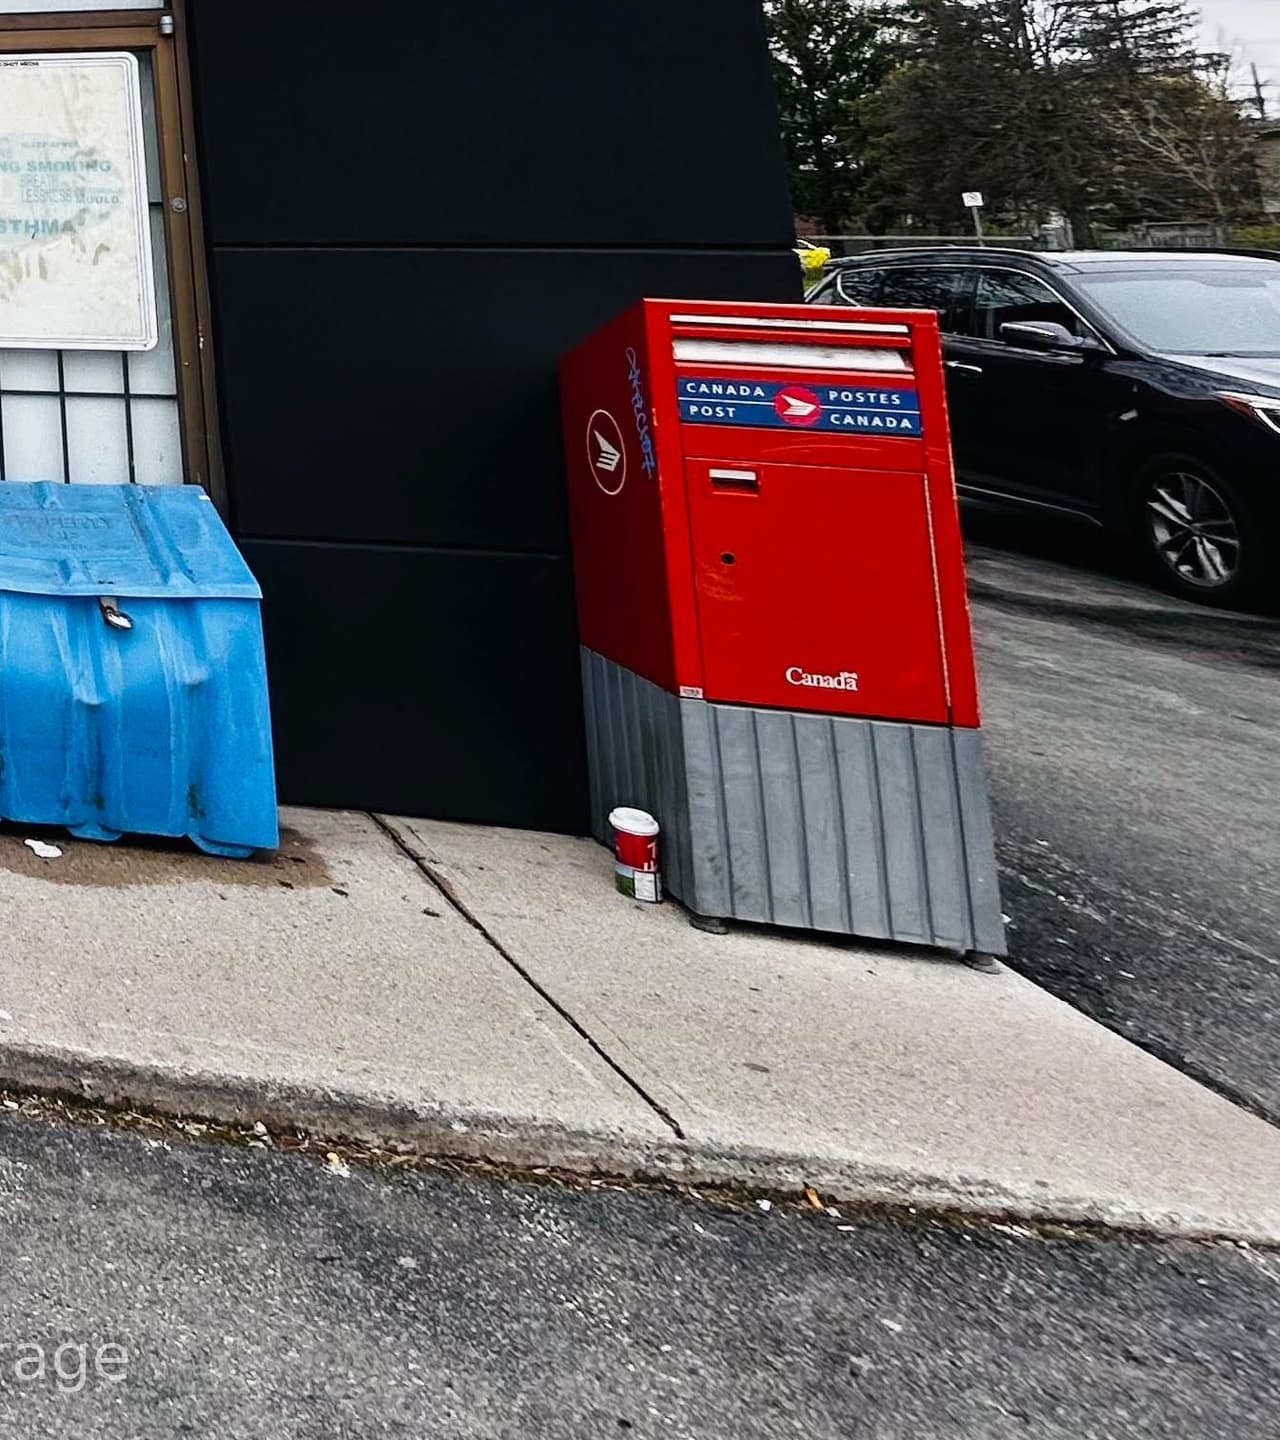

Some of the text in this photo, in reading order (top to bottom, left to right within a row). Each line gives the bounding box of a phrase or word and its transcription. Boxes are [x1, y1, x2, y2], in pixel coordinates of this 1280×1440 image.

[26, 159, 113, 173] SMOKING
[686, 382, 902, 405] CANADA POSTES
[690, 404, 914, 429] POST CANADA
[785, 666, 859, 692] Canada
